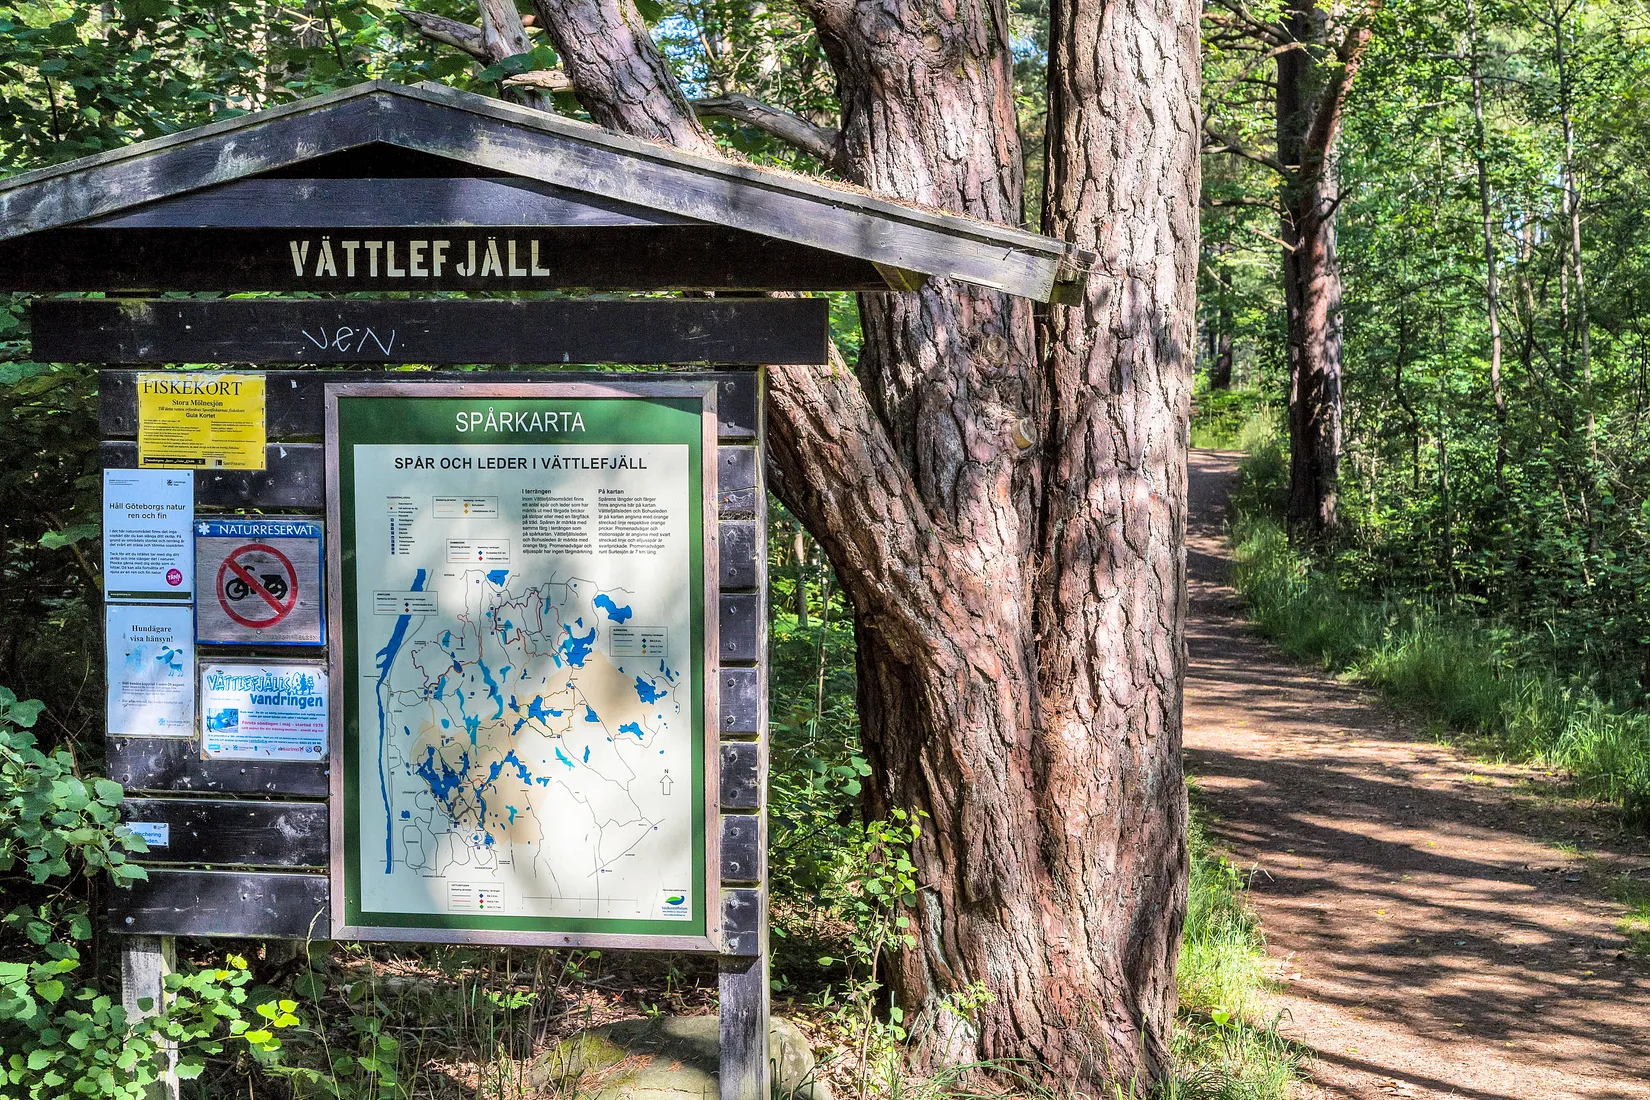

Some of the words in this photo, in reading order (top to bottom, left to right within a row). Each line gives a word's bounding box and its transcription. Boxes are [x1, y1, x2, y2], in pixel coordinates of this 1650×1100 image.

[290, 236, 550, 277] VÄTTLEFJÄLL
[144, 380, 242, 395] FISKEKORT
[456, 407, 586, 432] SPÅRKARTA
[394, 456, 435, 469] SPÅR
[440, 458, 472, 469] OCH
[478, 458, 528, 469] LEDER
[533, 458, 536, 468] I
[541, 455, 647, 469] VÄTTLEFJÄLL
[126, 503, 164, 511] Göteborgs
[220, 525, 313, 535] NATURRESERVAT
[132, 625, 171, 633] Hundägare
[146, 635, 173, 643] hänsyn!
[250, 692, 323, 709] vandringen
